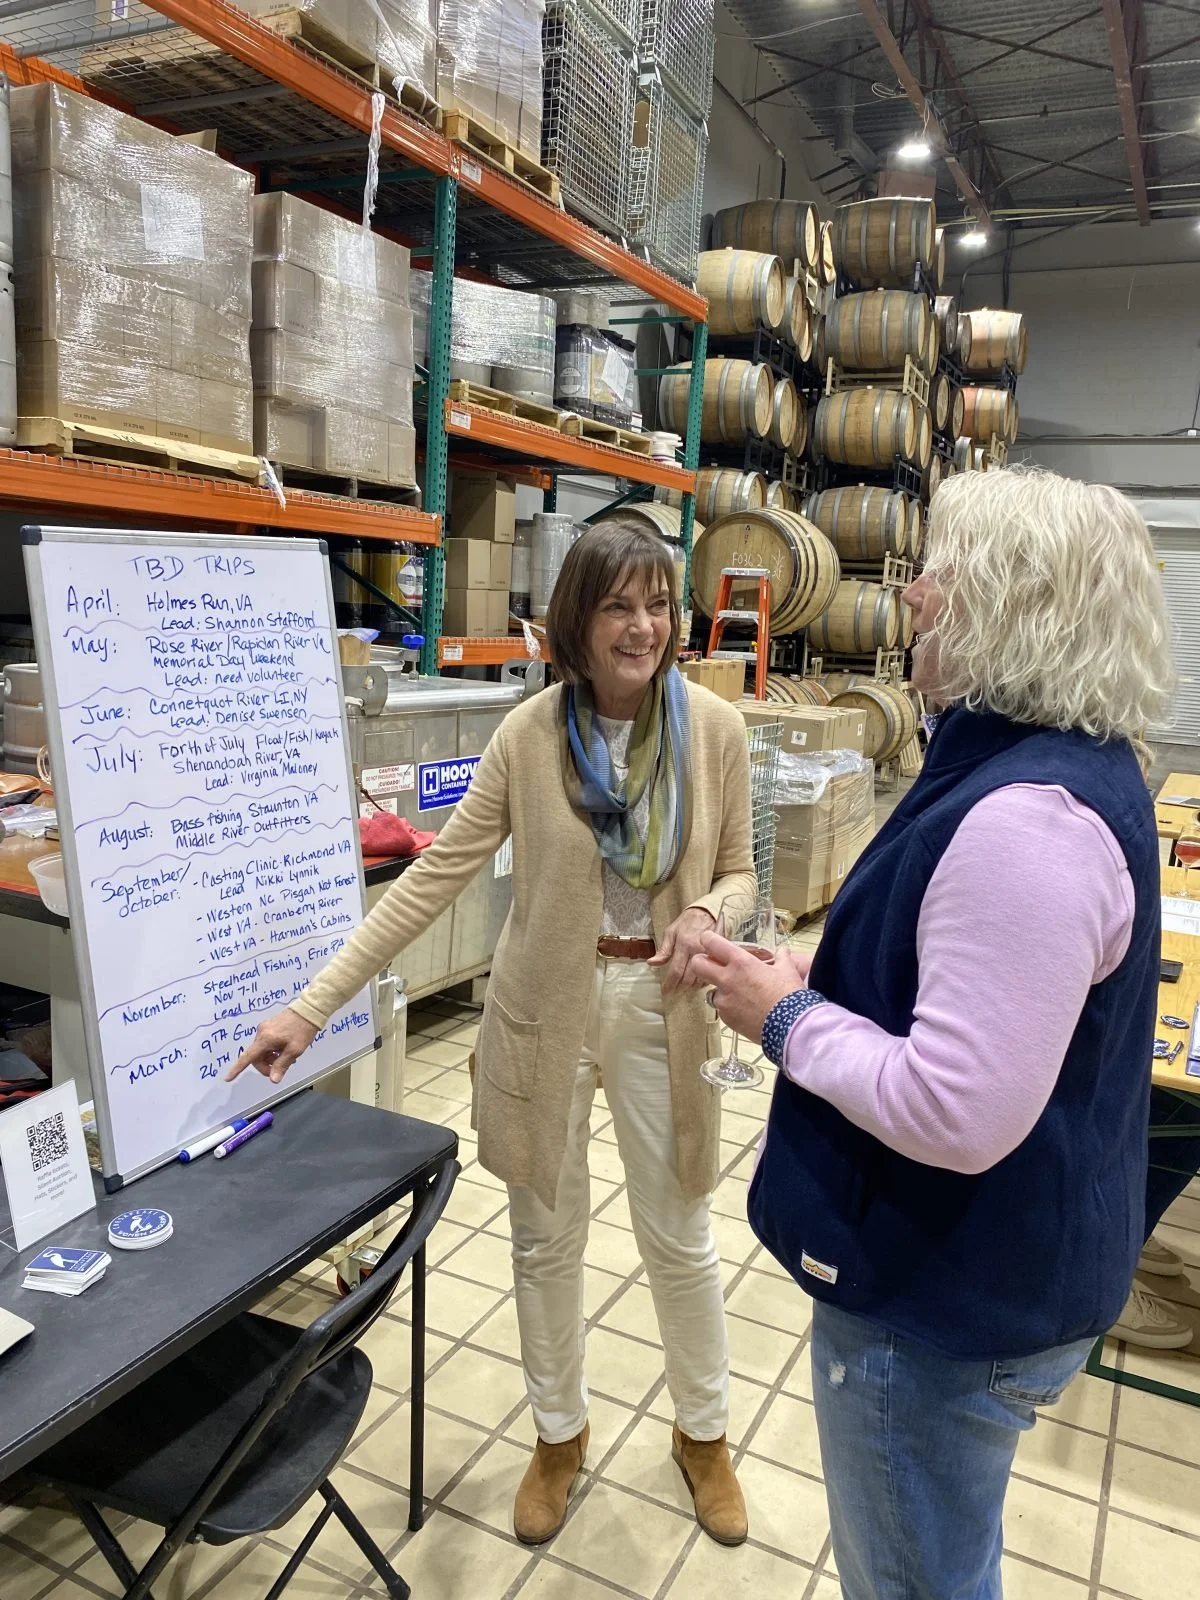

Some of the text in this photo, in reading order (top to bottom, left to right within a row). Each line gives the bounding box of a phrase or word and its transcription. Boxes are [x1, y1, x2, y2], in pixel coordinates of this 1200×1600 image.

[125, 555, 256, 581] TBD TRIPS
[67, 585, 120, 618] April:
[146, 590, 197, 612] Holmes
[204, 616, 264, 631] Shannon
[266, 610, 316, 628] Stafford
[145, 635, 186, 654] Rose
[284, 632, 310, 650] River
[153, 655, 215, 669] Memorial
[215, 654, 246, 671] Day
[215, 670, 243, 684] need
[247, 666, 304, 684] volunteer
[80, 704, 131, 725] June:
[149, 695, 233, 715] Connetquot
[236, 691, 270, 707] River
[215, 710, 256, 725] Denise
[259, 707, 308, 721] Swensen
[83, 743, 143, 774] July:
[158, 740, 202, 760] Forth
[217, 735, 246, 755] July
[173, 754, 252, 775] Shenandoah
[285, 747, 301, 760] VA
[240, 765, 279, 788] Virginia
[281, 761, 318, 777] Maloney
[440, 761, 480, 783] HOOV
[441, 780, 467, 790] CONTAINER
[99, 820, 153, 850] August:
[170, 818, 205, 834] Bass
[248, 797, 300, 818] Staunton
[304, 792, 319, 808] VA
[176, 815, 311, 849] Middle River Outfitters
[202, 866, 245, 888] Casting
[282, 843, 335, 867] Richmond
[338, 840, 351, 853] VA
[220, 882, 244, 900] Lead
[255, 870, 284, 889] Nikki
[206, 902, 252, 923] Western
[260, 894, 275, 907] NC
[207, 926, 232, 943] West
[237, 917, 251, 934] VA
[263, 902, 316, 924] Cranberry
[318, 896, 343, 908] River
[210, 943, 240, 962] West
[243, 937, 256, 951] VA
[320, 912, 351, 929] Cabins
[204, 959, 260, 994] Steelhead
[308, 946, 328, 960] Erie
[213, 991, 234, 1006] Nov
[214, 1003, 242, 1021] Lead
[248, 989, 287, 1011] Kristen
[129, 1048, 187, 1084] March:
[233, 1023, 258, 1041] Gun
